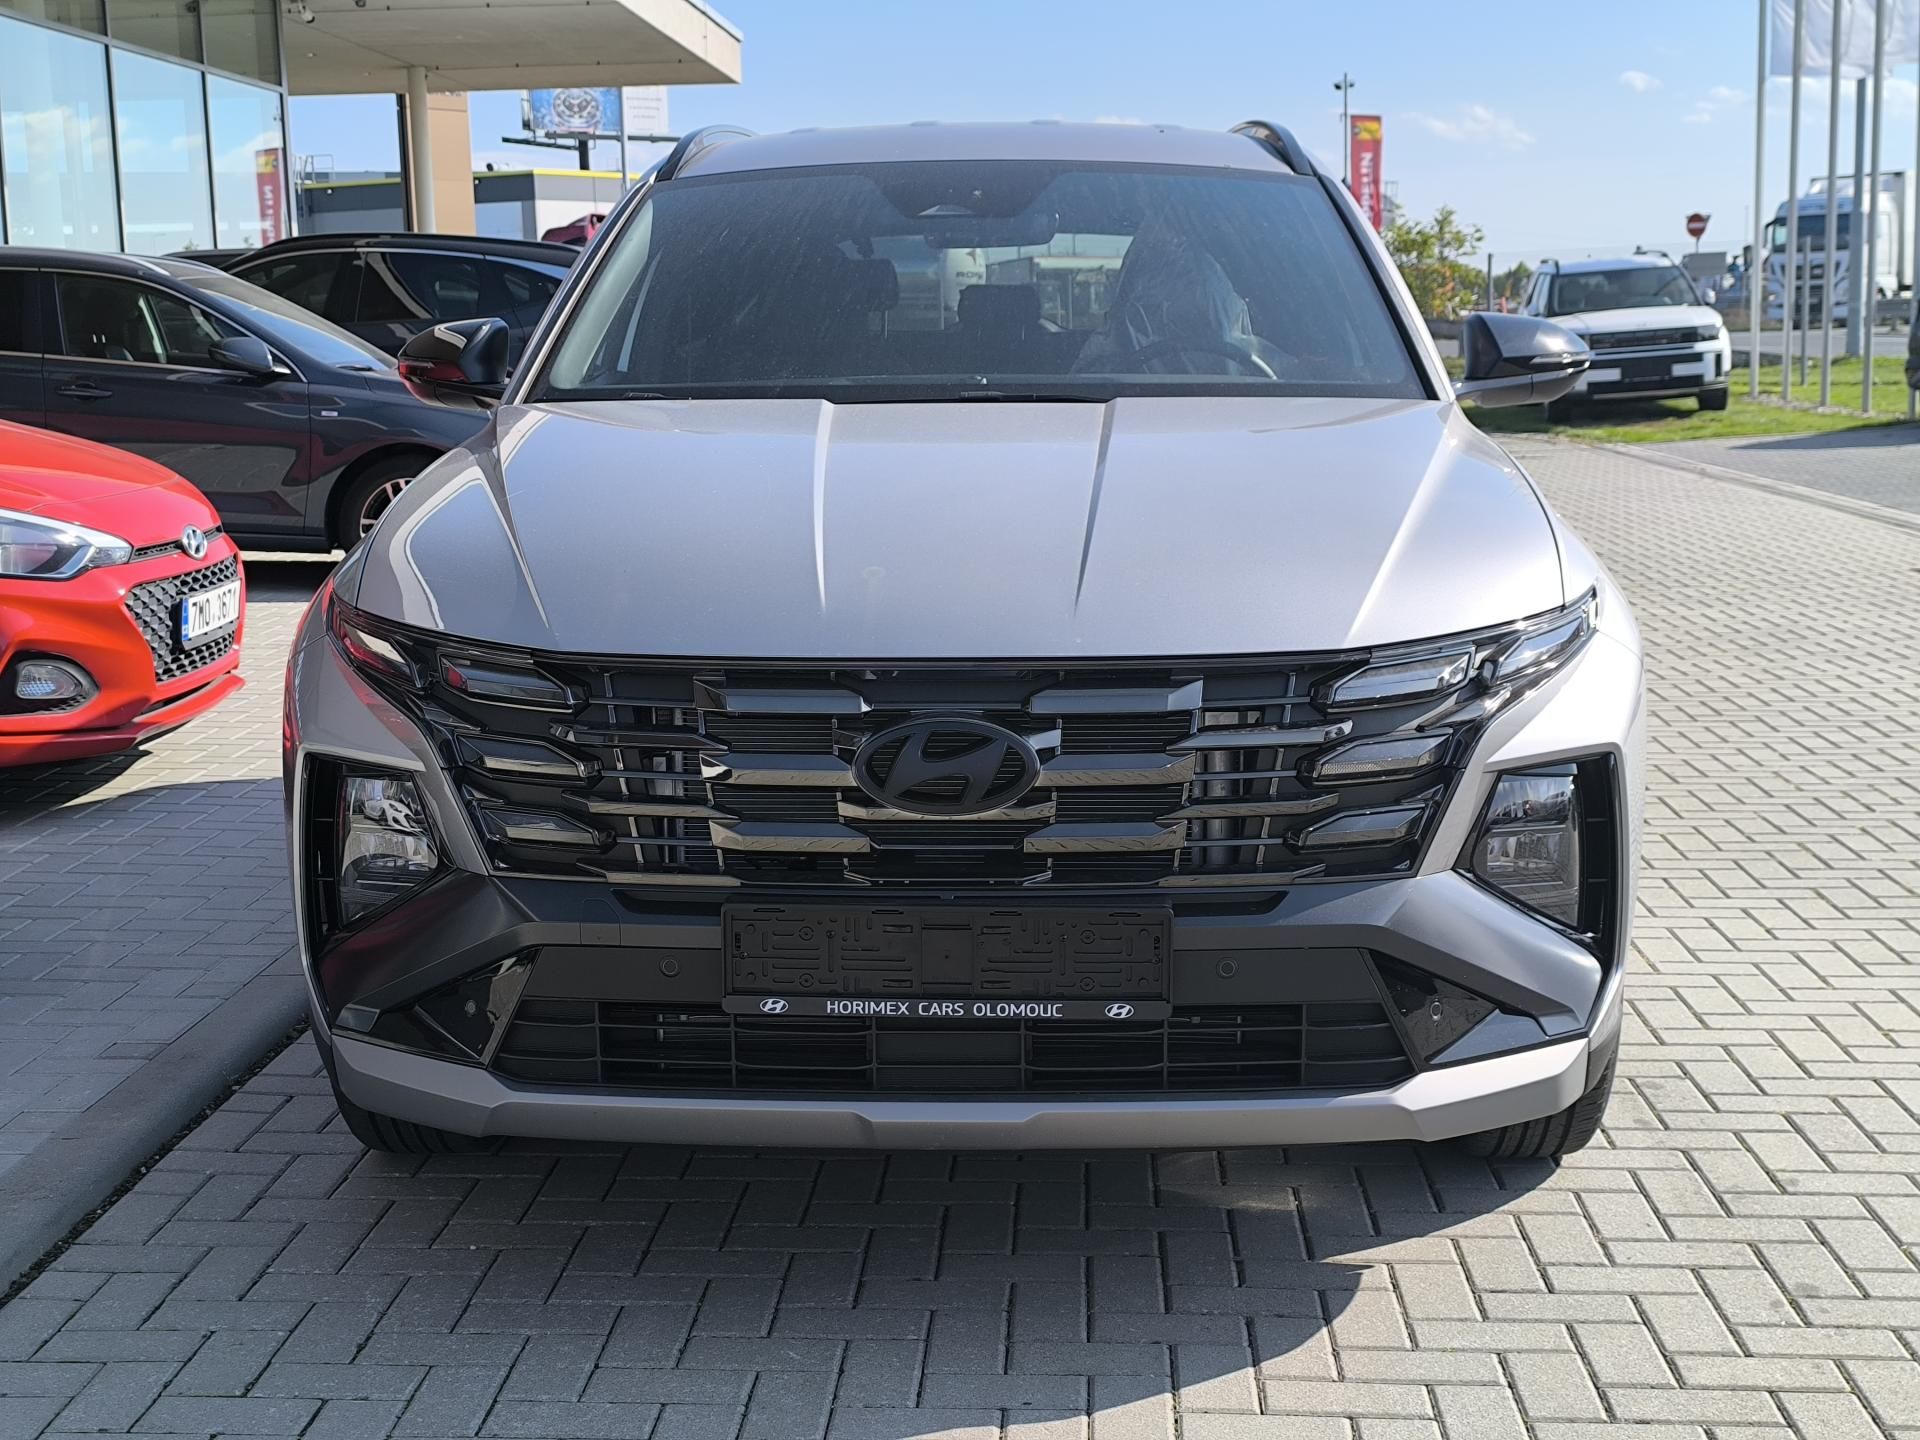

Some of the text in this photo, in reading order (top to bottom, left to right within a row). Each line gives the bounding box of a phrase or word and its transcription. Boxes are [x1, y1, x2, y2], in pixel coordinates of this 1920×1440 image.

[826, 1000, 1064, 1018] HORIMEX CARS OLOMOUC
